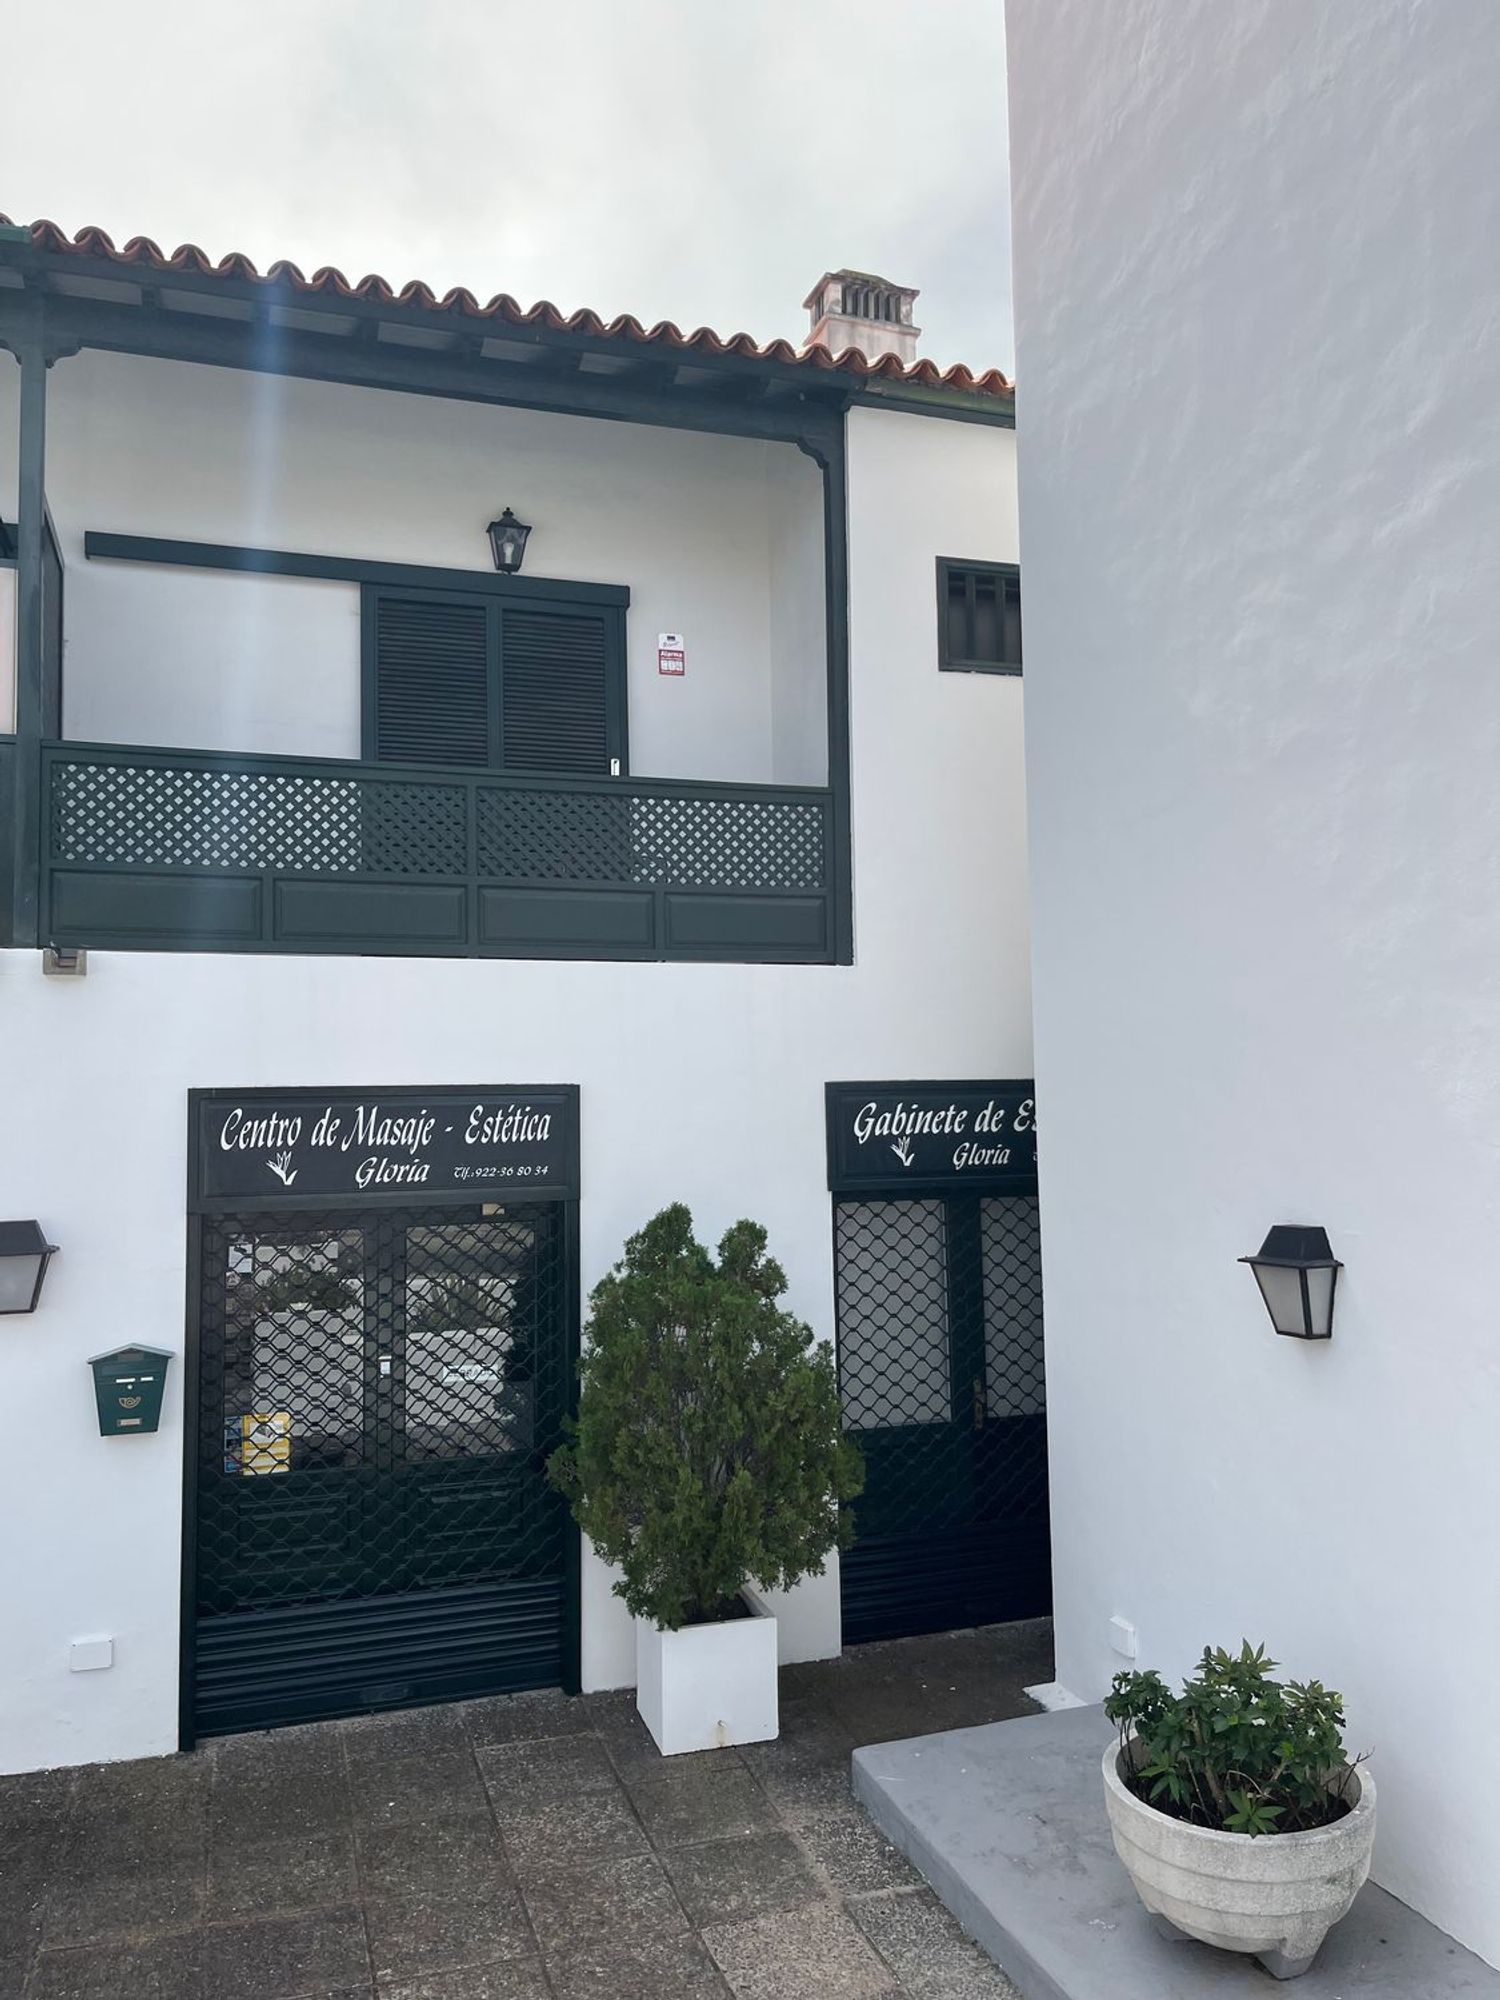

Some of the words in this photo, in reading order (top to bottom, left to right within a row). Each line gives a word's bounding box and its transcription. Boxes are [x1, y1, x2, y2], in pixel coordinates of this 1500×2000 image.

[220, 1108, 302, 1151] Centro
[310, 1106, 340, 1147] de
[341, 1105, 436, 1155] Masaje
[464, 1104, 552, 1144] Estética
[853, 1102, 969, 1145] Gabinete
[974, 1100, 1006, 1133] de
[1013, 1099, 1037, 1132] E
[355, 1156, 431, 1189] Gloria
[516, 1166, 532, 1176] 80
[534, 1165, 549, 1176] 34
[953, 1142, 1011, 1170] Gloria
